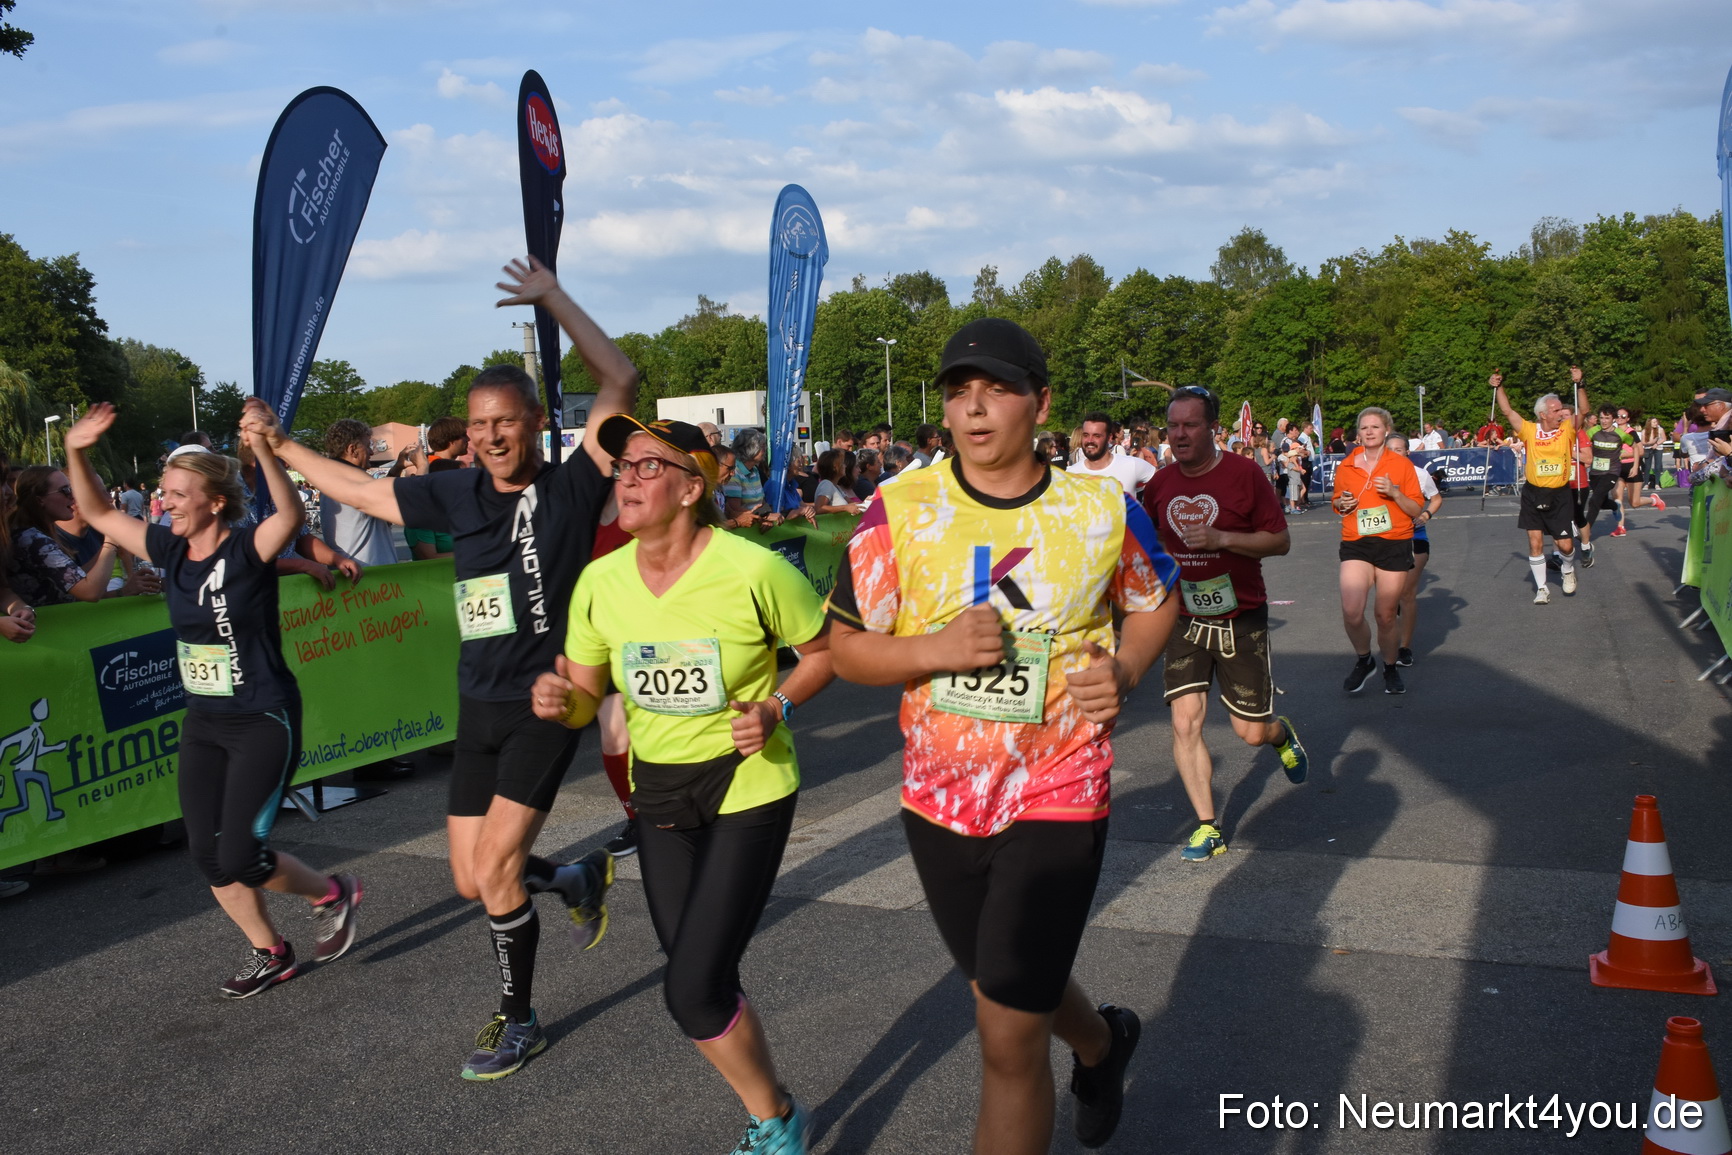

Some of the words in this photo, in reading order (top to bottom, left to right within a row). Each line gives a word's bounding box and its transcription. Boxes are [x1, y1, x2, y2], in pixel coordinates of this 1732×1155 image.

[301, 128, 343, 227] Fischer
[319, 147, 351, 226] AUTOMOBILE
[1540, 463, 1559, 472] 1537
[1177, 512, 1204, 521] Jürgen
[1361, 515, 1387, 528] 1794
[518, 521, 550, 635] RAIL.ONE
[340, 583, 405, 613] Firmen
[461, 597, 501, 622] 1945
[1192, 591, 1223, 606] 696
[211, 593, 244, 686] RAIL.ONE
[295, 626, 358, 664] laufen
[359, 600, 429, 643] länger!
[116, 656, 175, 685] Fischer
[123, 671, 173, 692] AUTOMOBILE
[183, 662, 219, 681] 1931
[634, 667, 709, 696] 2023
[995, 697, 1026, 706] Marcel
[78, 758, 174, 808] neumarkt
